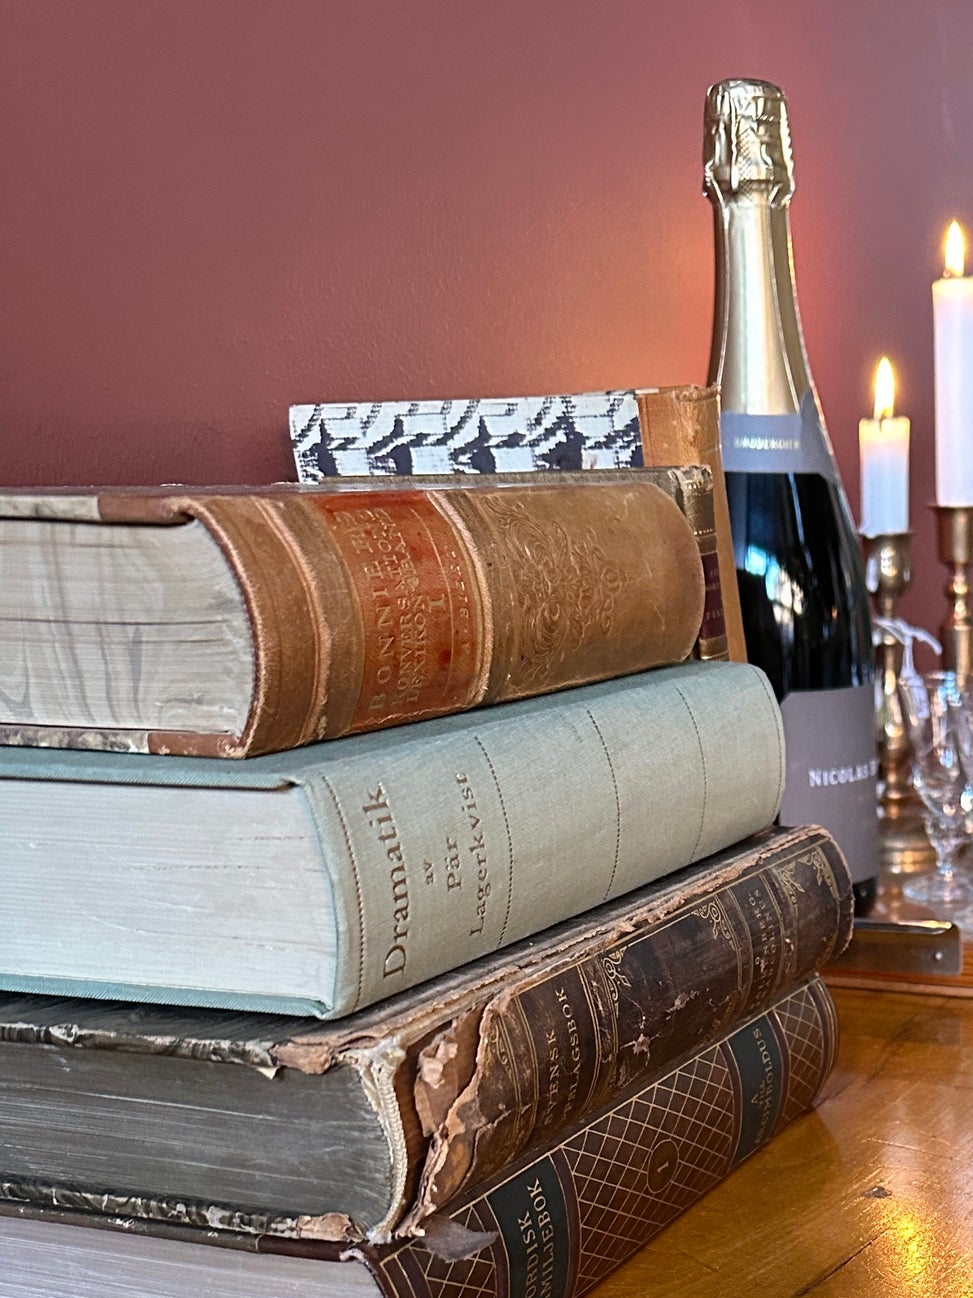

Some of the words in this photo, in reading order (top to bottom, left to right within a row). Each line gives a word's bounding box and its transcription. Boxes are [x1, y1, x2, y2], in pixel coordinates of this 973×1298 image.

[333, 509, 394, 712] BONNIERS
[403, 593, 428, 703] LEXIKON
[362, 781, 411, 980] Dramatik
[422, 859, 435, 886] av
[445, 836, 463, 893] Pär
[455, 771, 492, 937] Lagerkvist
[543, 1028, 561, 1126] SVENSK
[553, 986, 582, 1122] PPSLAGSBOK
[656, 1160, 668, 1174] 1
